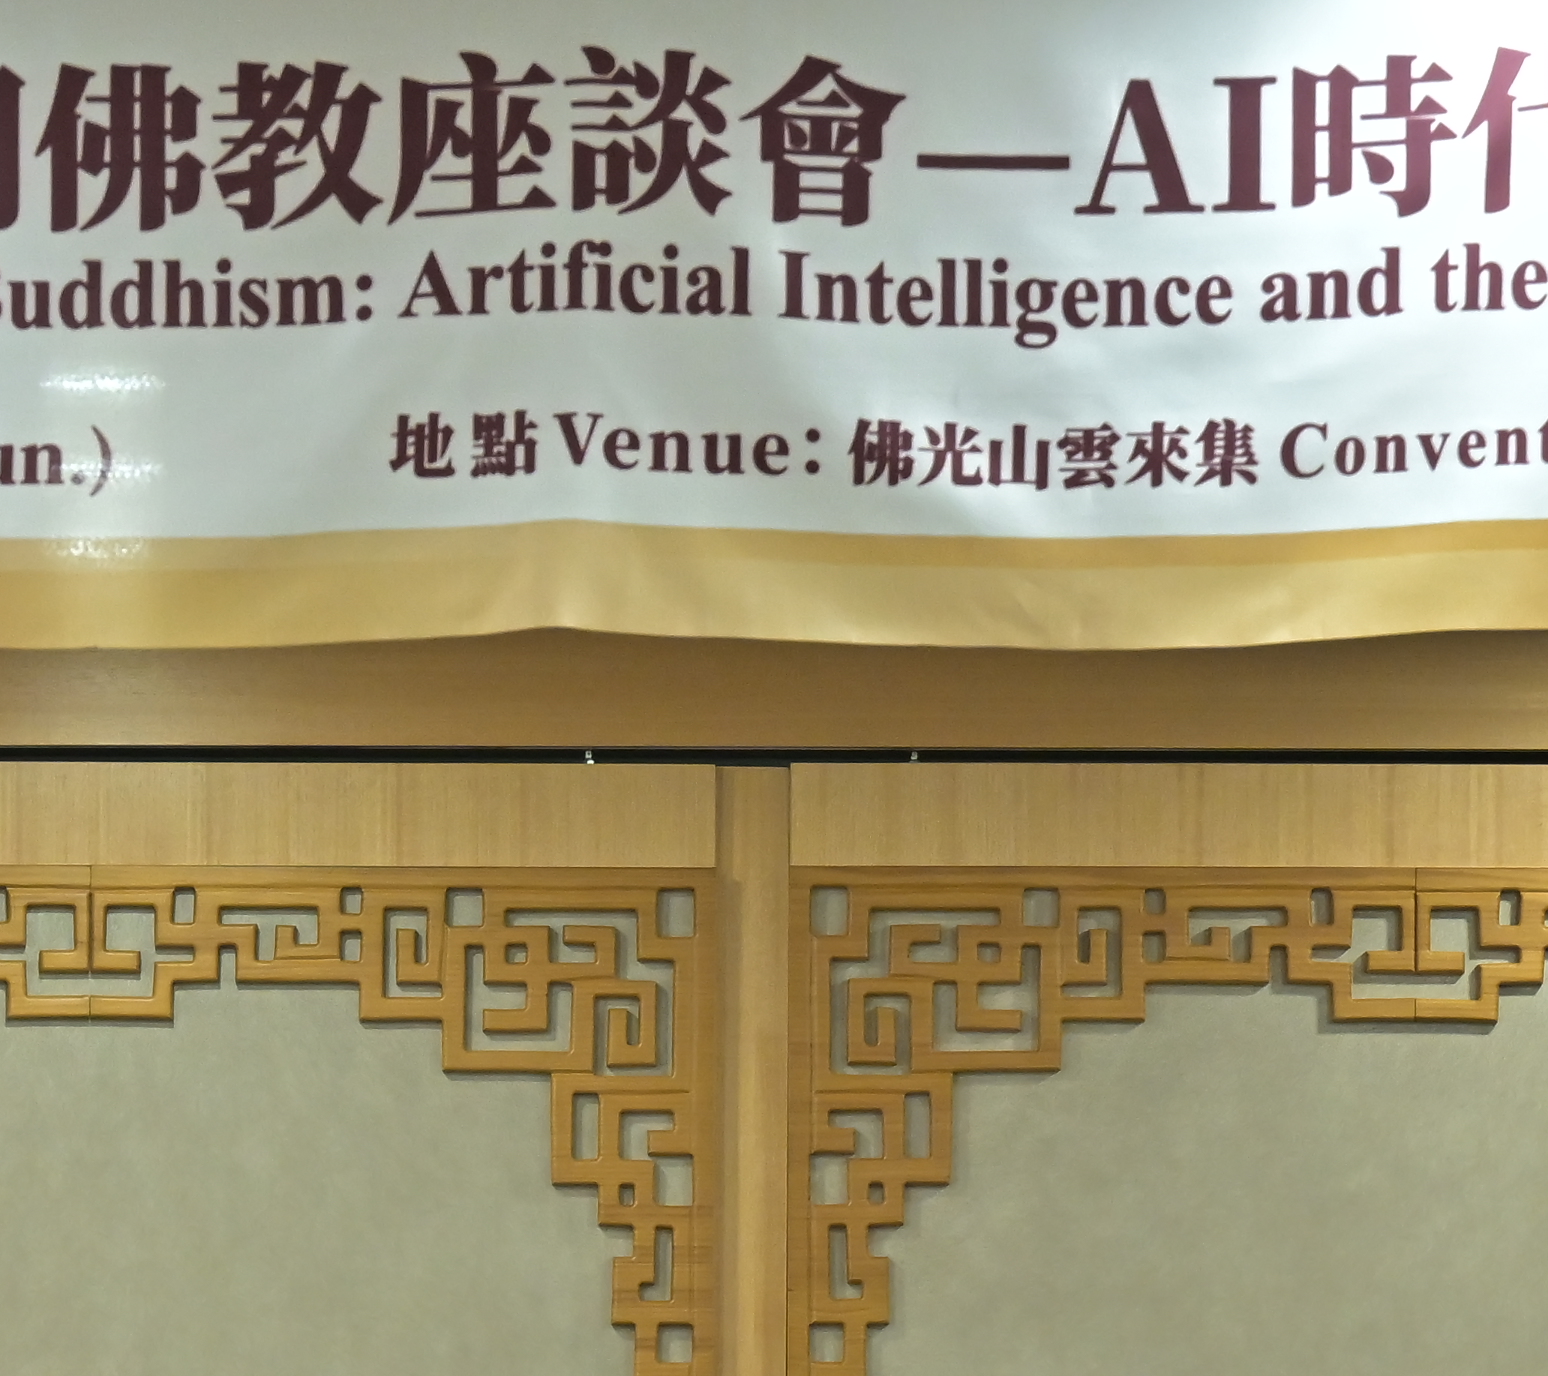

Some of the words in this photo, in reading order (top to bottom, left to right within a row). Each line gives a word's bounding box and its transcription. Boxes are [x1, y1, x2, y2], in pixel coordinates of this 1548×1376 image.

[397, 243, 752, 319] Artificial
[777, 247, 1232, 348] Intelligence
[1260, 255, 1403, 323] and
[1432, 243, 1548, 312] the
[848, 418, 1258, 492] 佛光山雲來集
